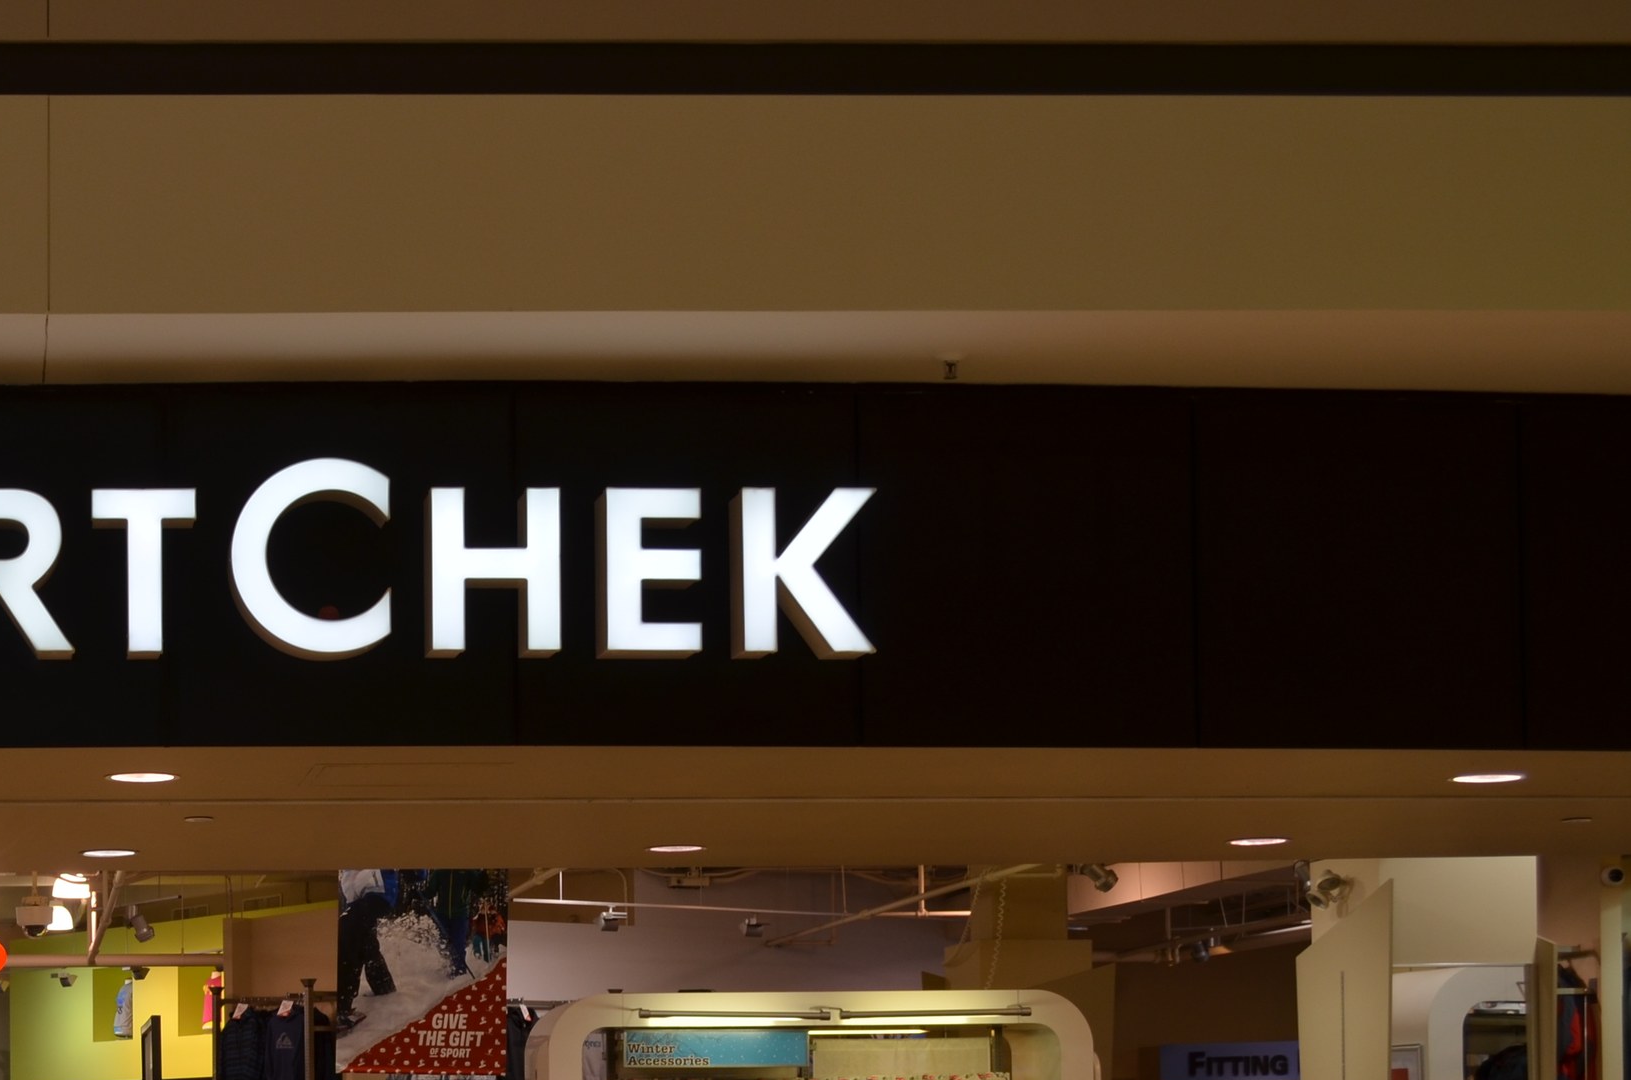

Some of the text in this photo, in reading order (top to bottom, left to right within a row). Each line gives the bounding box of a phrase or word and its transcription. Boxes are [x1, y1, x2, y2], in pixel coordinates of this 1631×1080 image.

[431, 1013, 468, 1030] GIVE
[417, 1030, 484, 1047] THE GIFT
[429, 1047, 471, 1058] OF SPORT
[628, 1043, 675, 1054] Winter
[627, 1055, 709, 1066] Accessories
